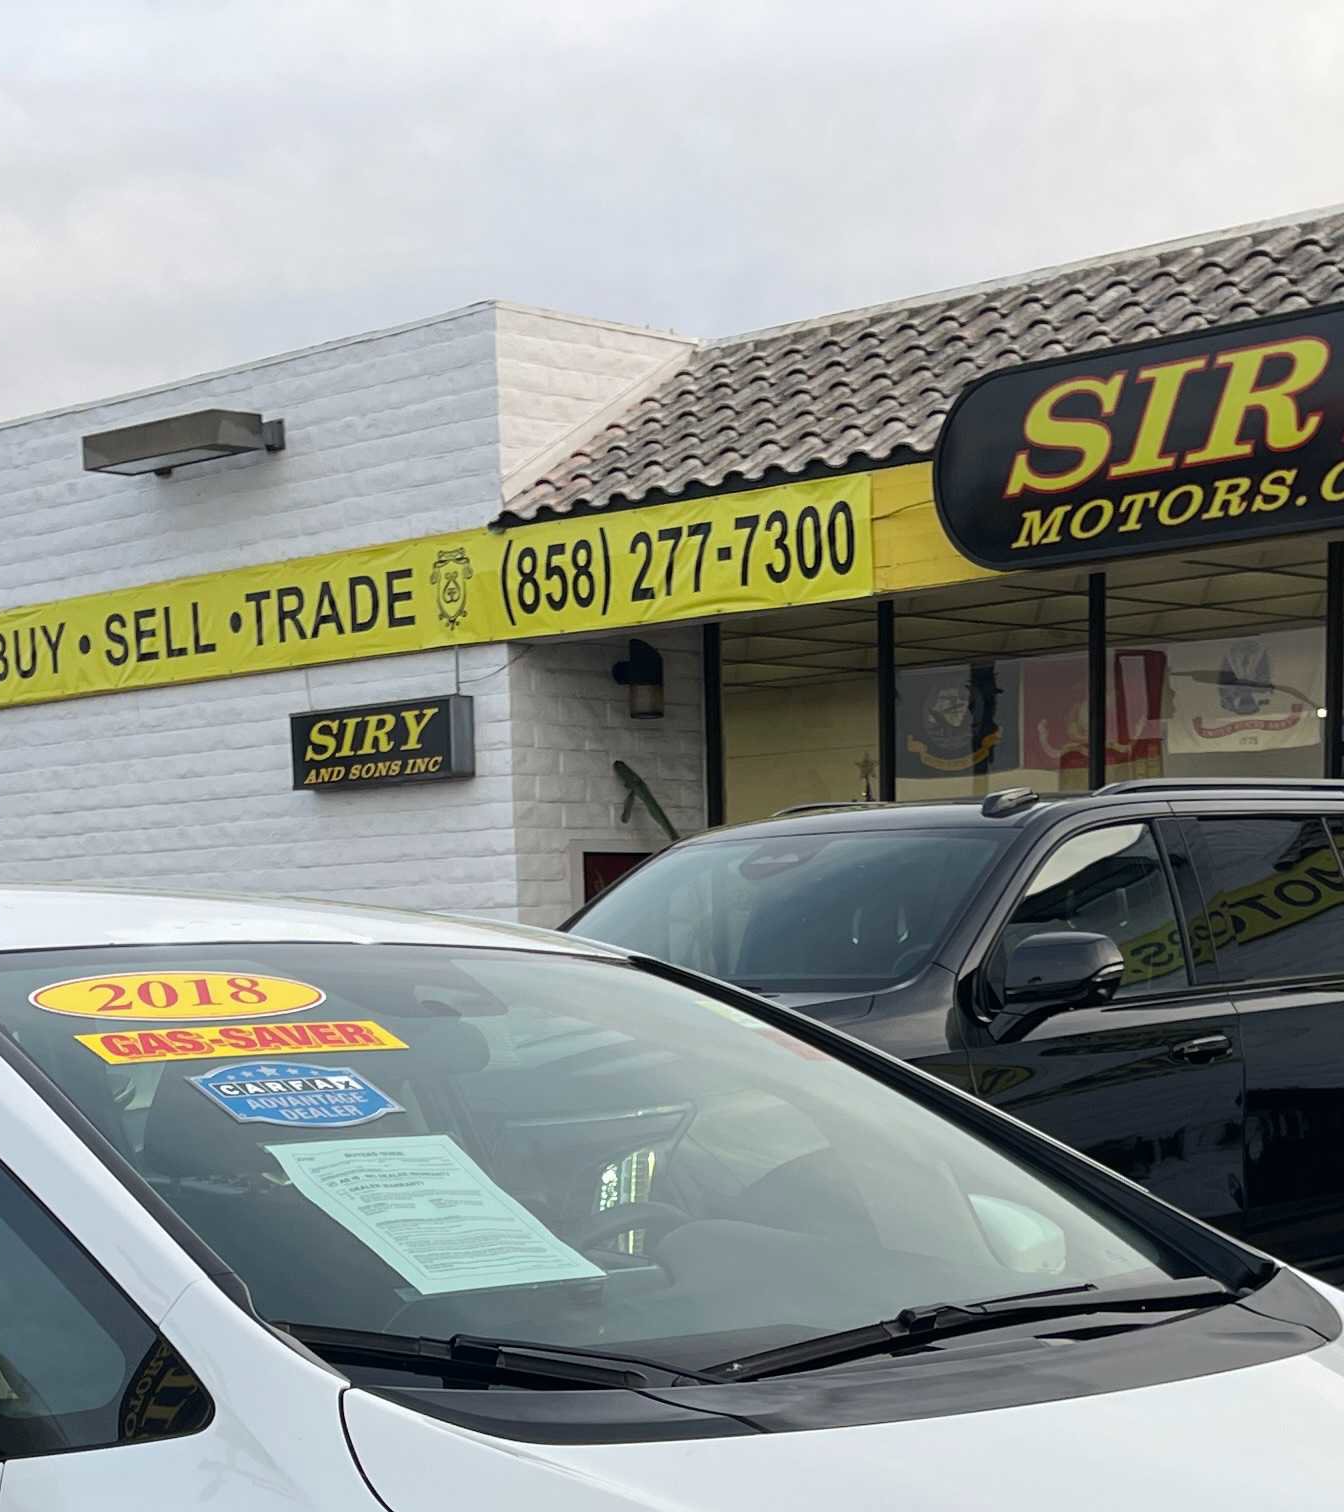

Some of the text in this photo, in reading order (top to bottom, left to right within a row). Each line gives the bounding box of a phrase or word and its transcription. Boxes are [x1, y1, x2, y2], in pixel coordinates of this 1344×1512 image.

[501, 500, 855, 627] (858) 277-7300
[105, 602, 217, 667] SELL
[246, 569, 416, 646] TRADE
[305, 706, 438, 762] SIRY
[305, 756, 442, 785] AND SONS INC
[88, 977, 268, 1013] 2018
[100, 1023, 373, 1060] GAS-SAVER
[219, 1076, 364, 1096] CARFAX
[246, 1092, 368, 1110] ADVANTAGE
[279, 1105, 364, 1120] DEALER
